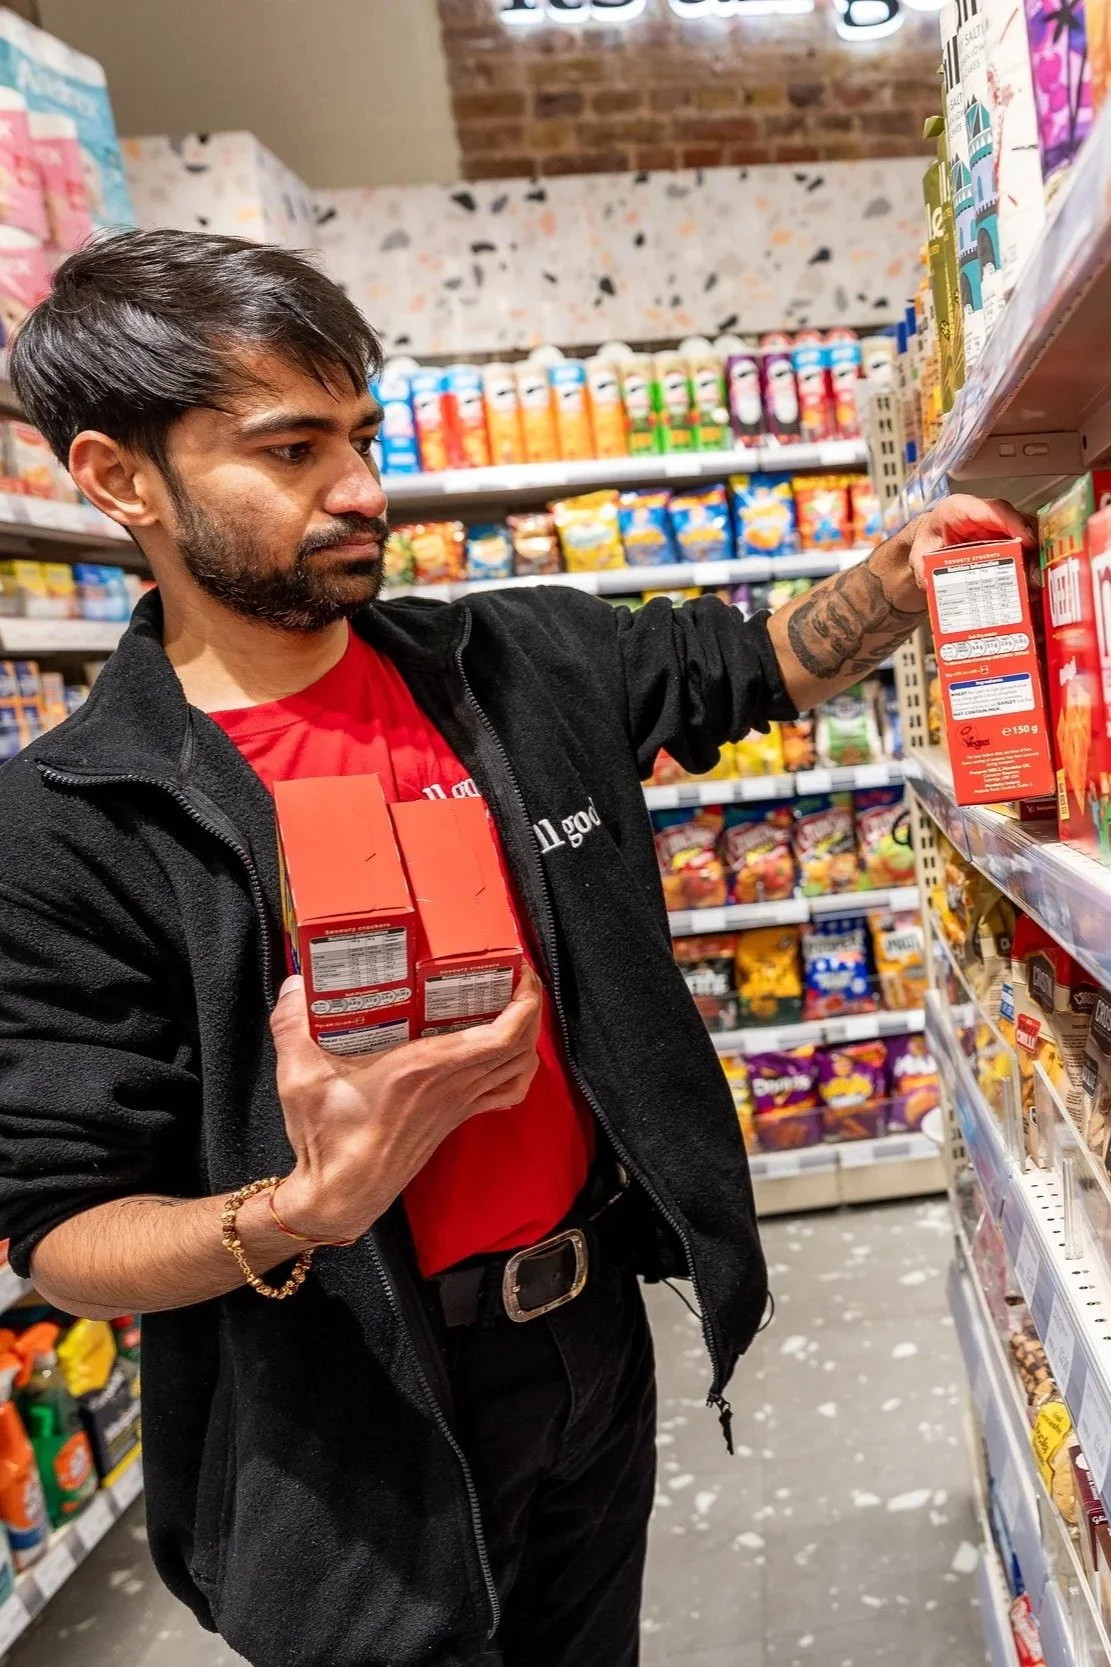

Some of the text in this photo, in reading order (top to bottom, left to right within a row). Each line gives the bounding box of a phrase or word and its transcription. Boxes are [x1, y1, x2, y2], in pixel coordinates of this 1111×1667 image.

[971, 552, 1000, 561] crackers
[1031, 725, 1038, 734] g
[358, 922, 391, 932] crackers
